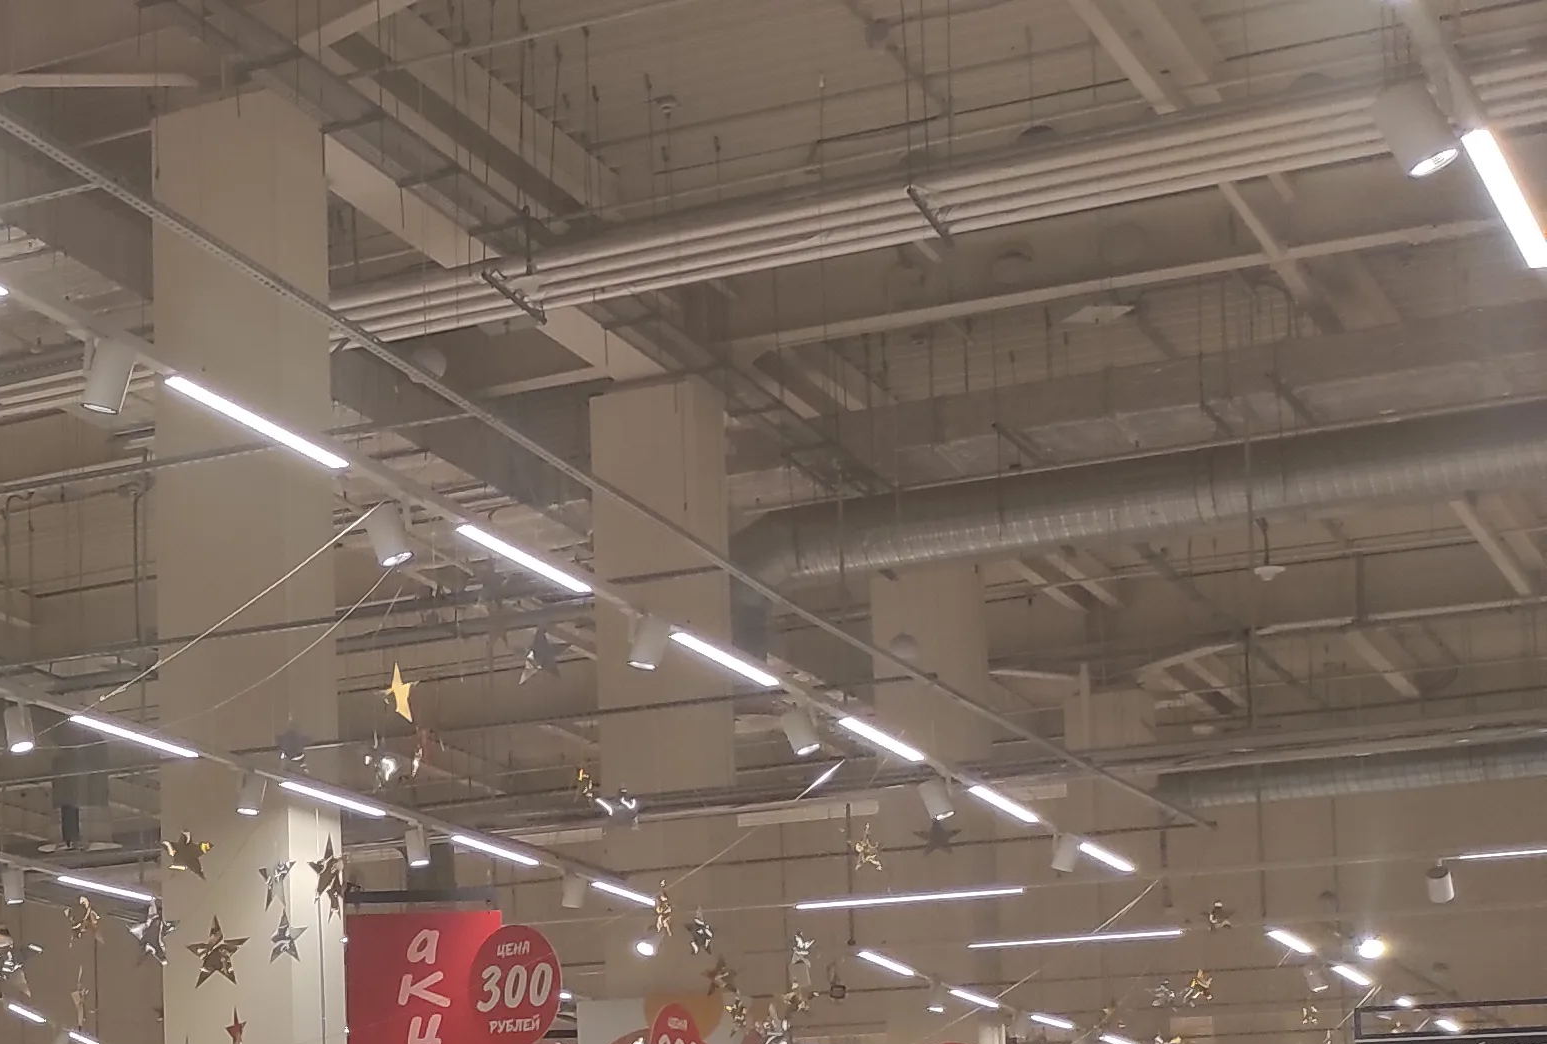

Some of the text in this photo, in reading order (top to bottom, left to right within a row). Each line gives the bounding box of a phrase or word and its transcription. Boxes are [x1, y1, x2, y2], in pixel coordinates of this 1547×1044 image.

[496, 941, 531, 957] ЦЕНА
[476, 962, 554, 1013] 300
[488, 1014, 541, 1034] РУБЛЕЙ
